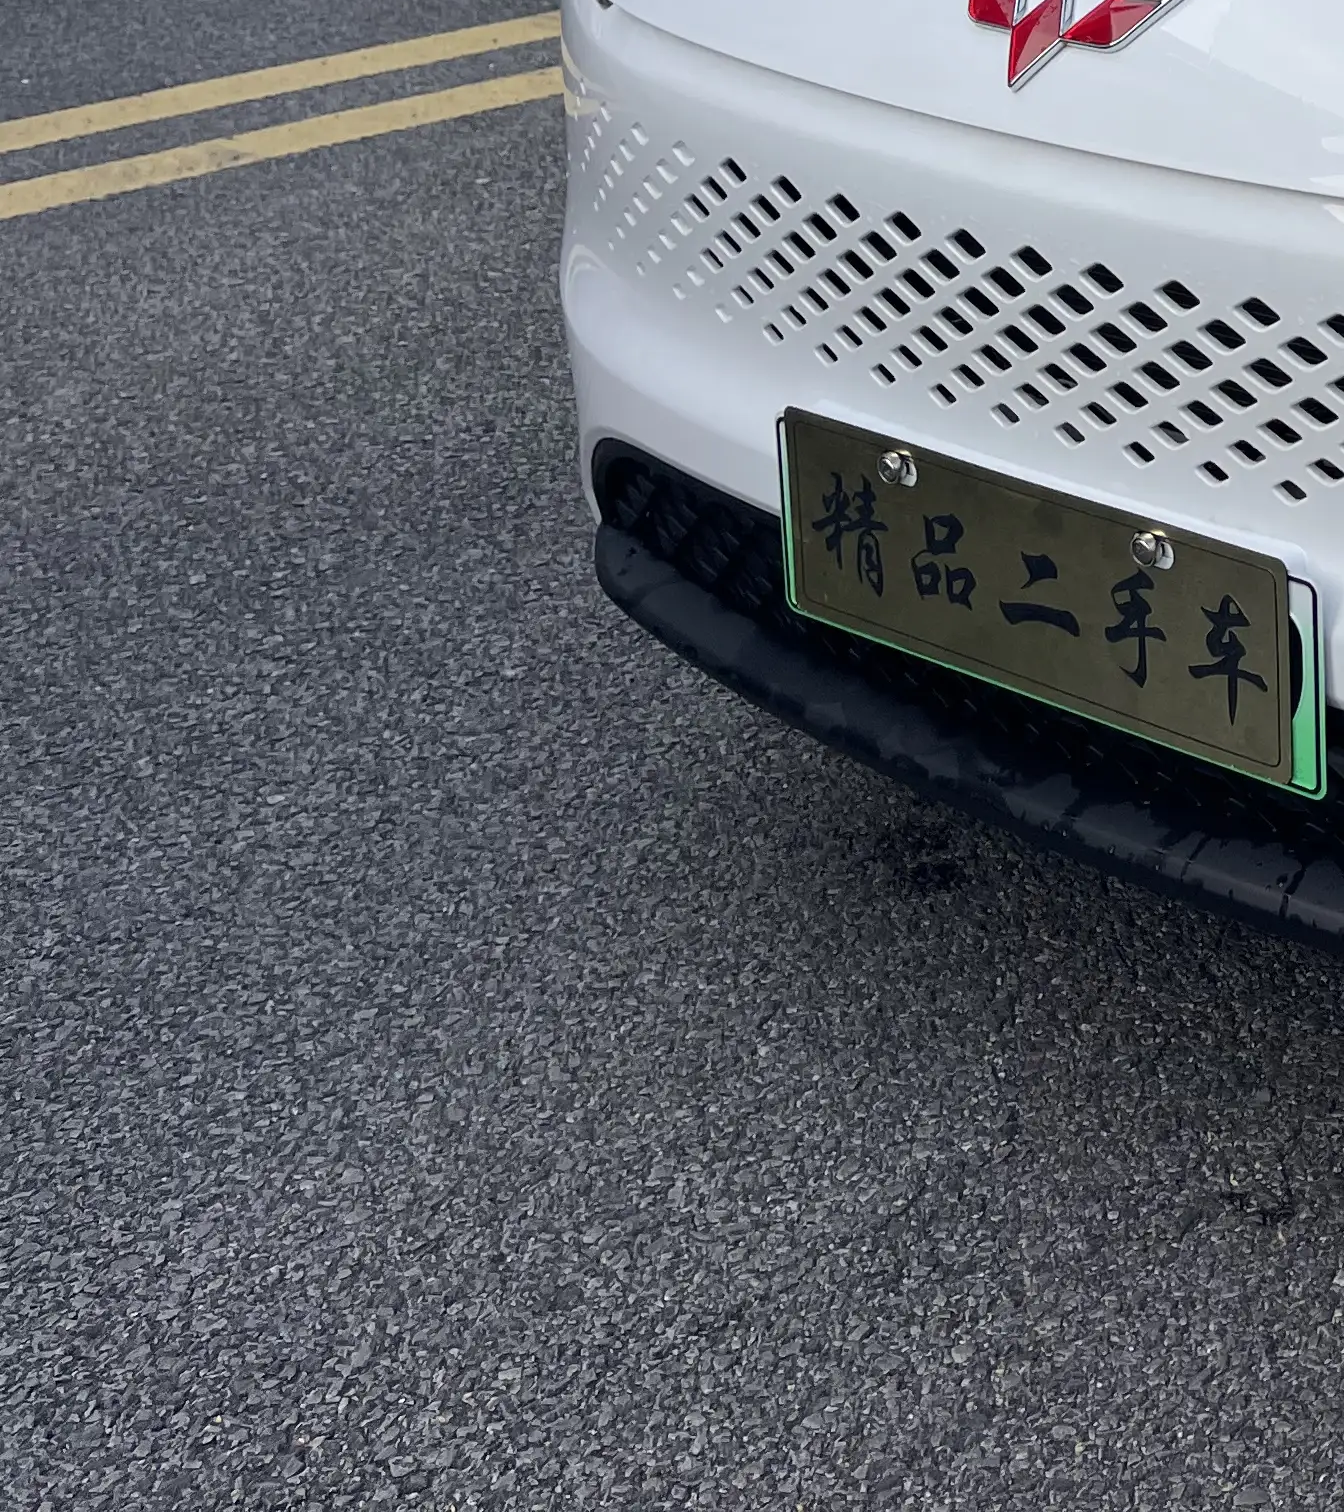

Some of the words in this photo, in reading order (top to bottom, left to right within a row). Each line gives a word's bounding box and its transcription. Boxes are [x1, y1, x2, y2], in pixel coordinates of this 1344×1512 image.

[812, 472, 1268, 726] 精品二手车
